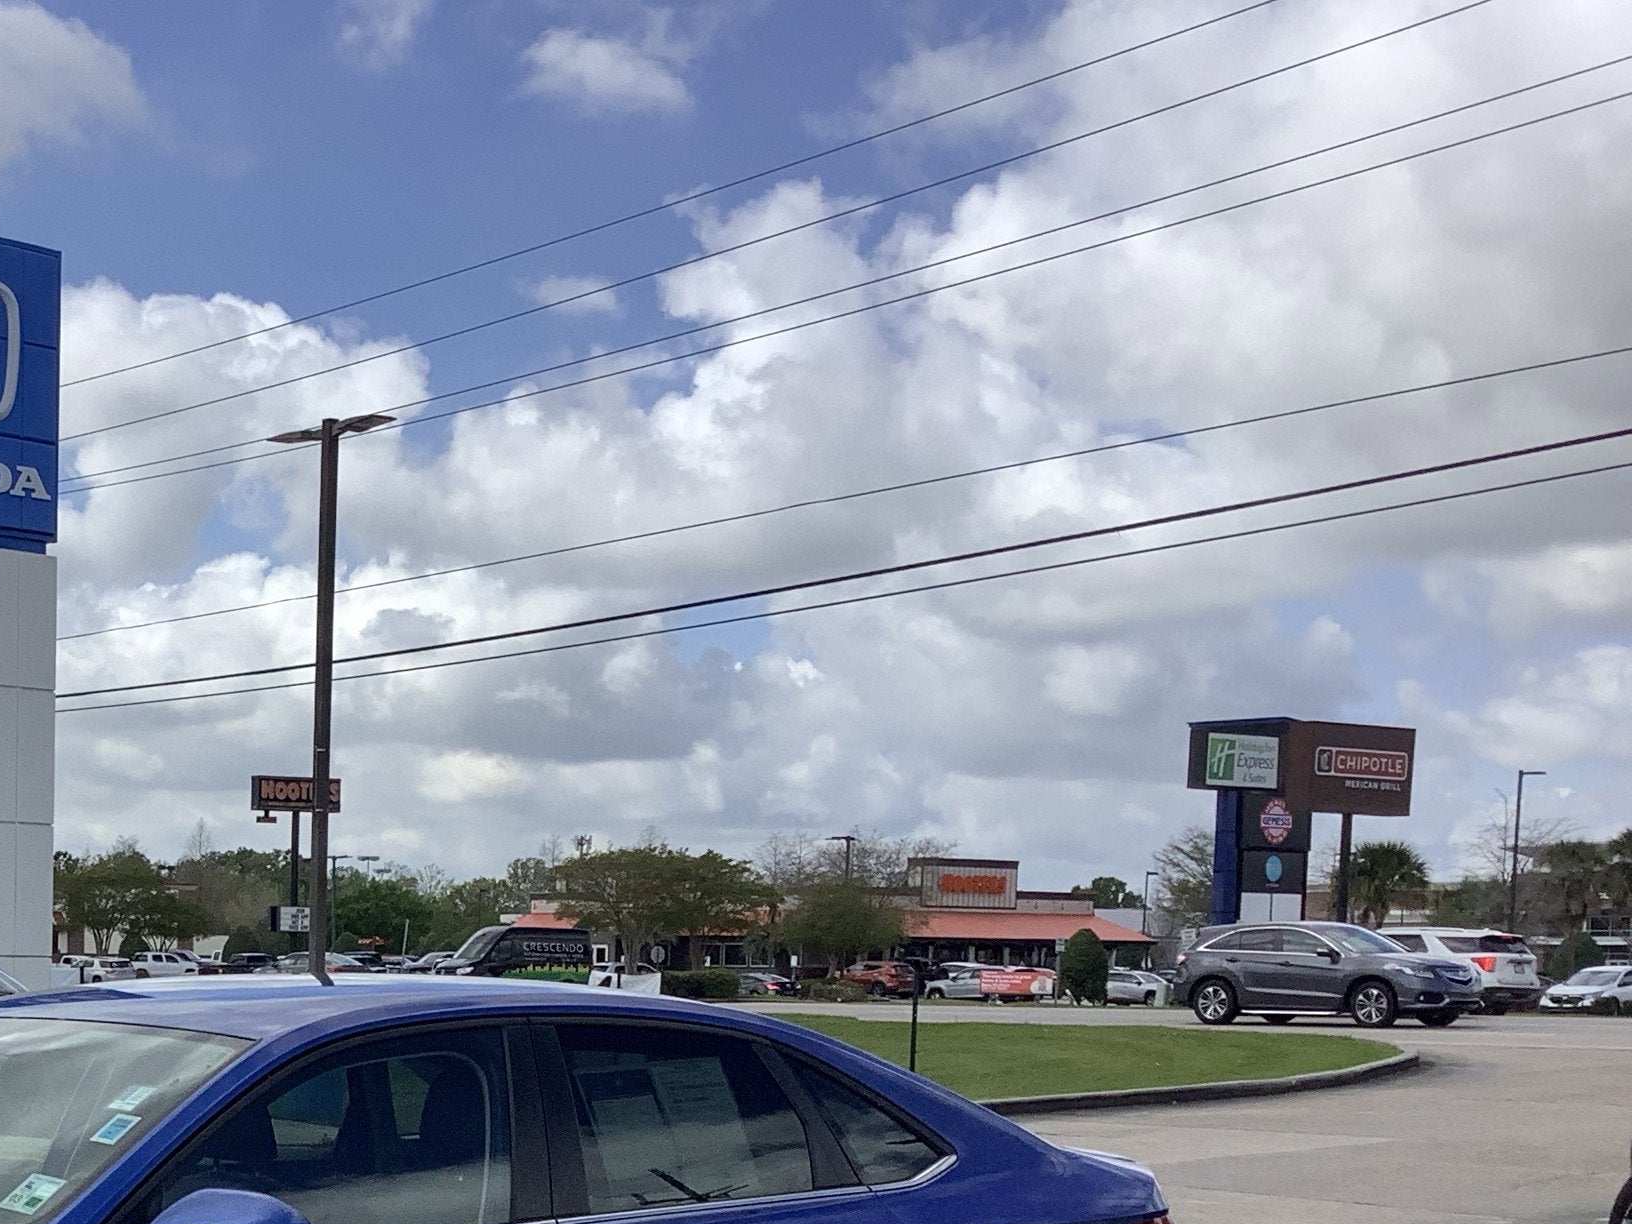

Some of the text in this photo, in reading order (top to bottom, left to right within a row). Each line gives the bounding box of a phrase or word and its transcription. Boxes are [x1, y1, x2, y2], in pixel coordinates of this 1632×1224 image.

[1237, 752, 1275, 770] Express
[1336, 755, 1404, 774] CHIPOTLE
[261, 779, 339, 802] HOOTS
[1344, 780, 1378, 790] MEXICAN
[522, 941, 585, 953] CRESCENDO
